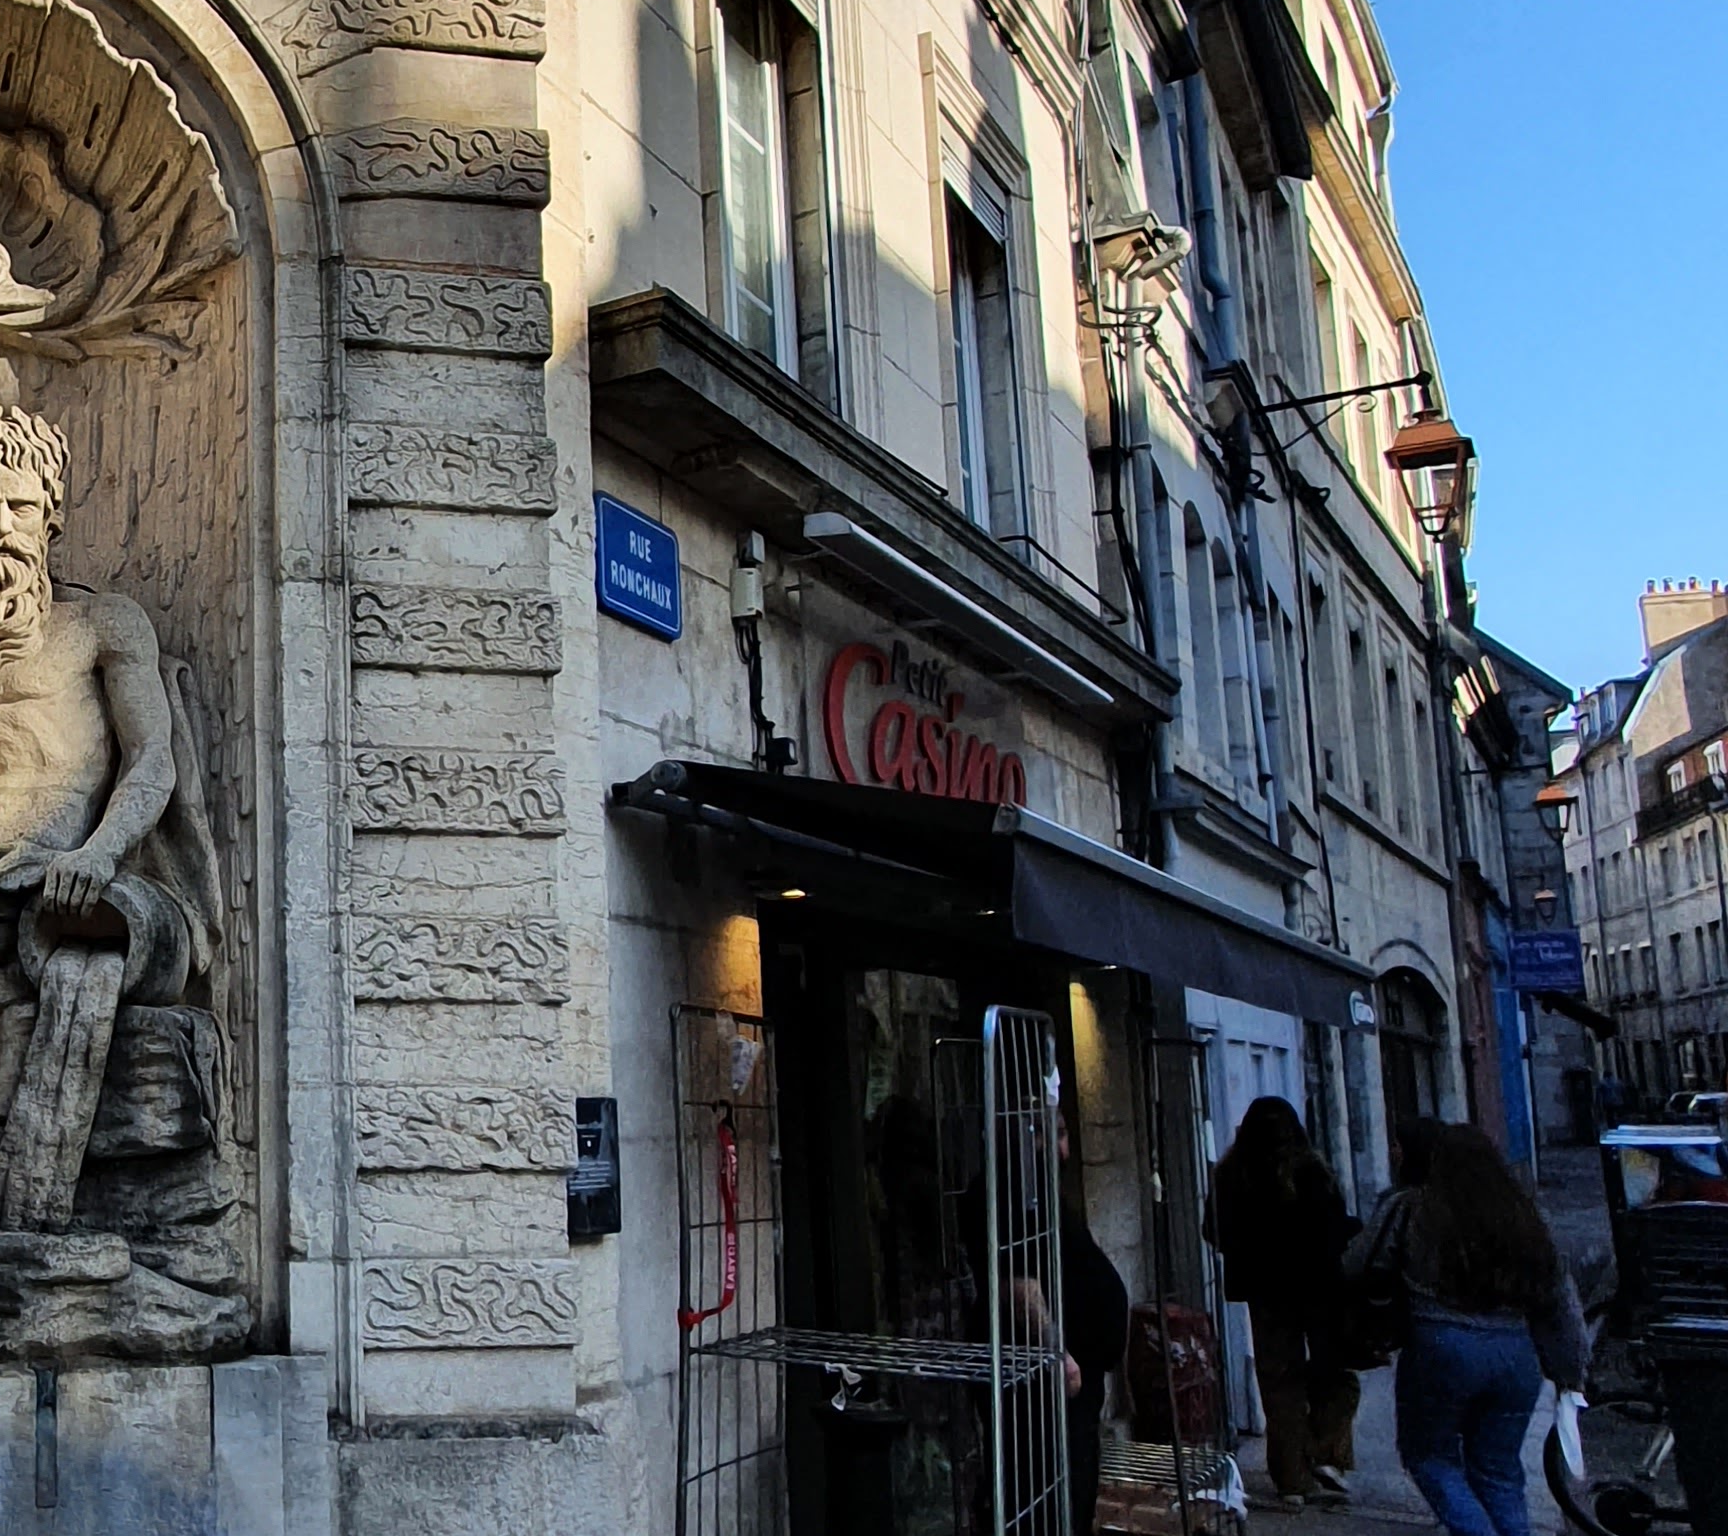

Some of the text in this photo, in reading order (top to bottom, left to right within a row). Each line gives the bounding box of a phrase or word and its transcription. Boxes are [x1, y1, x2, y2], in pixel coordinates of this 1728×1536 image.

[629, 530, 652, 563] RUE
[610, 560, 672, 612] RONCHAUX
[891, 639, 947, 708] Petit
[823, 642, 1027, 807] Casino
